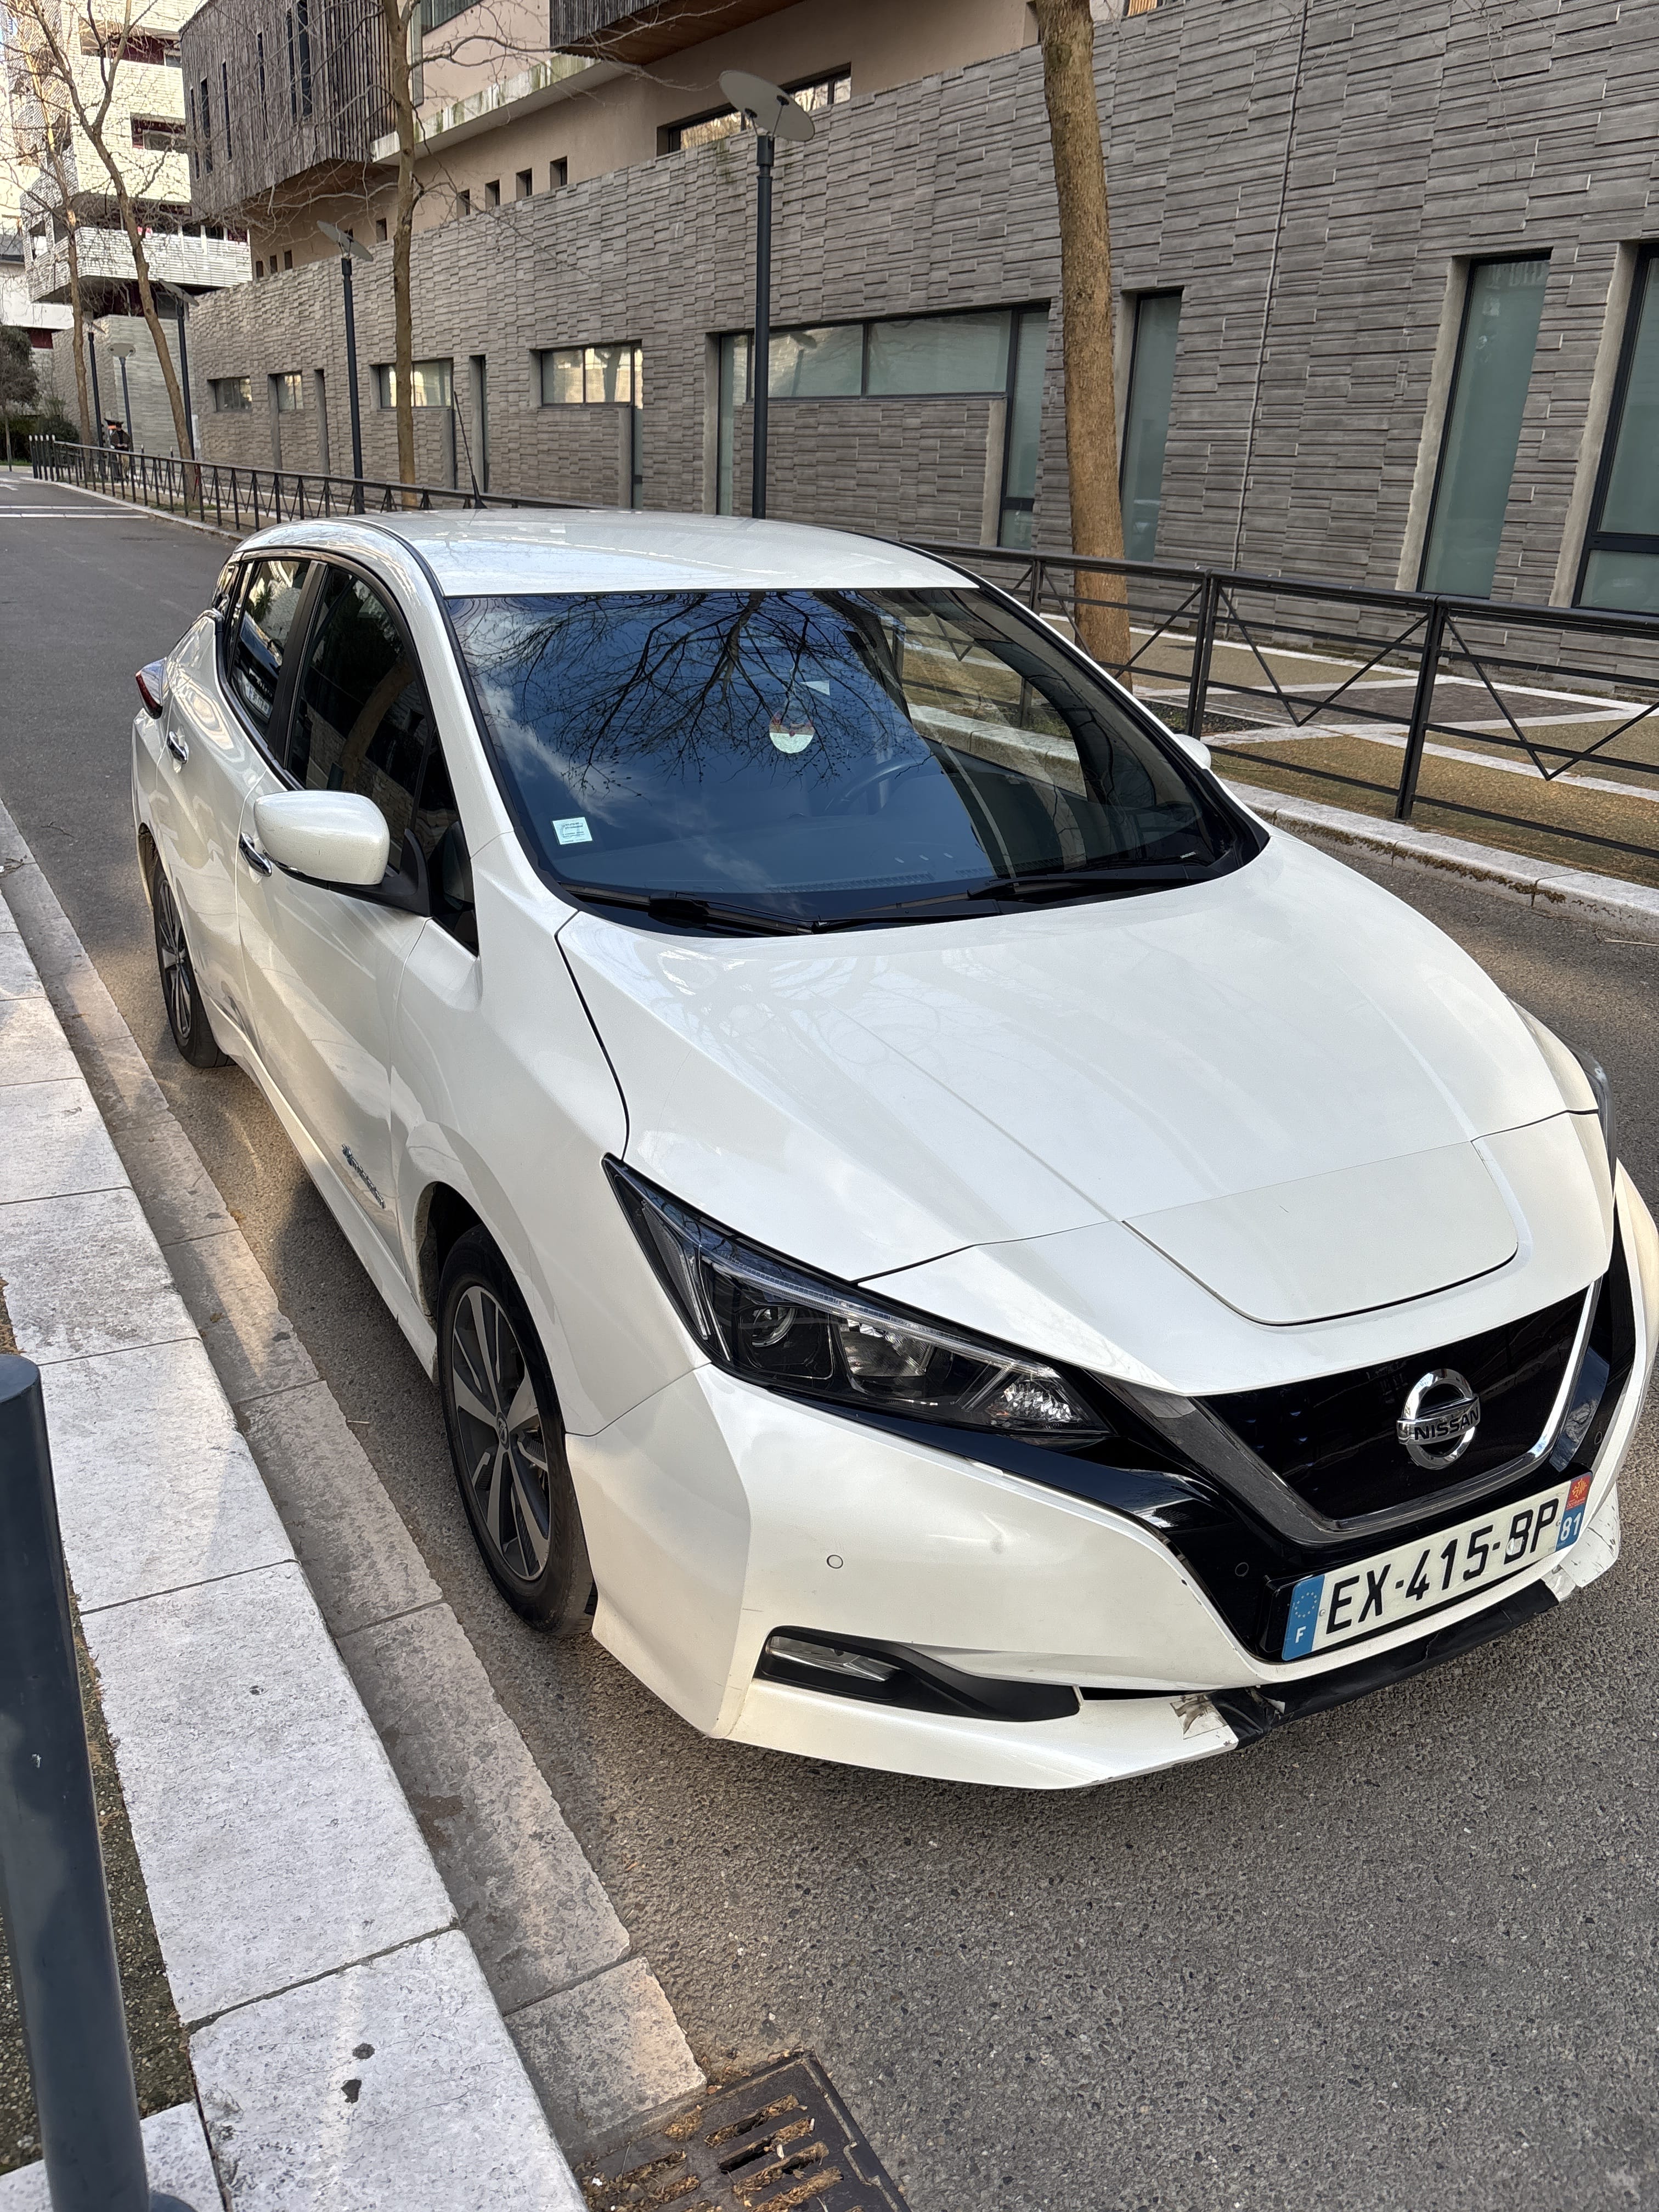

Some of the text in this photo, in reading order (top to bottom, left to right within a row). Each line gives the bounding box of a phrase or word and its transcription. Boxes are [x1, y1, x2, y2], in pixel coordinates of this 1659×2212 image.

[1414, 1406, 1479, 1440] NISSAN
[1560, 1512, 1582, 1541] 81
[1326, 1498, 1559, 1634] EX-415-BP
[1295, 1626, 1306, 1643] F
